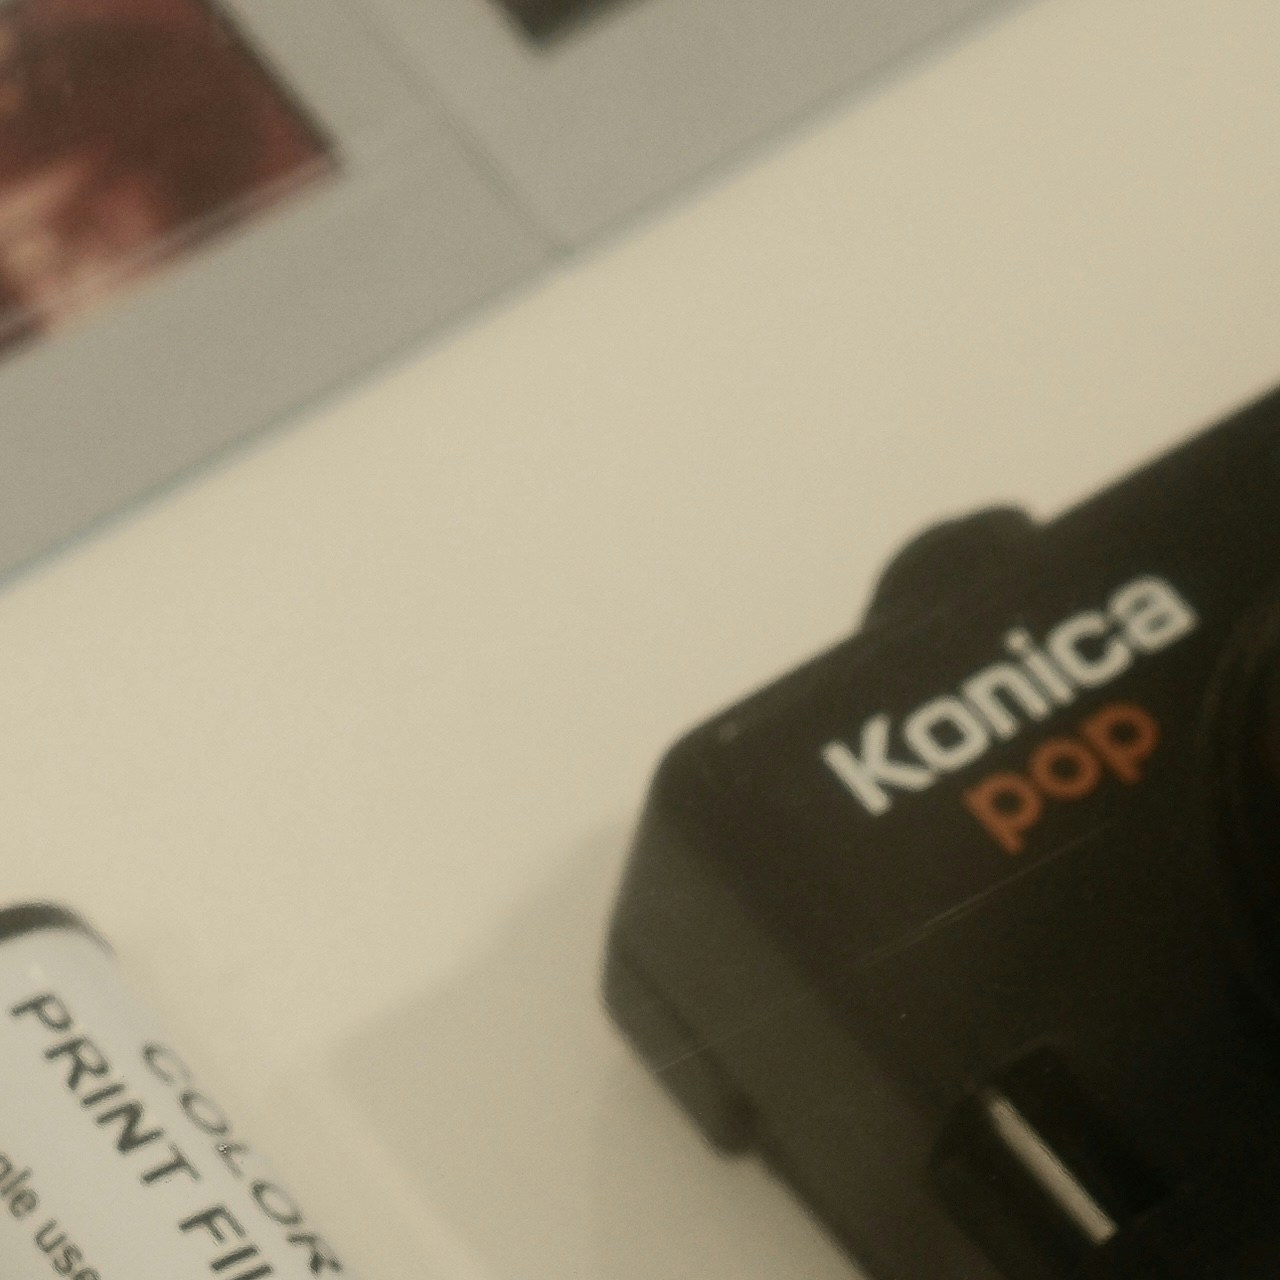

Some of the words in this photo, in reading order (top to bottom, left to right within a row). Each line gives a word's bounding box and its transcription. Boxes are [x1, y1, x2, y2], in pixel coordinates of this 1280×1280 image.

[822, 573, 1202, 818] Konica
[965, 701, 1163, 857] pop
[11, 993, 201, 1190] PRINT
[141, 1040, 344, 1279] COLOR
